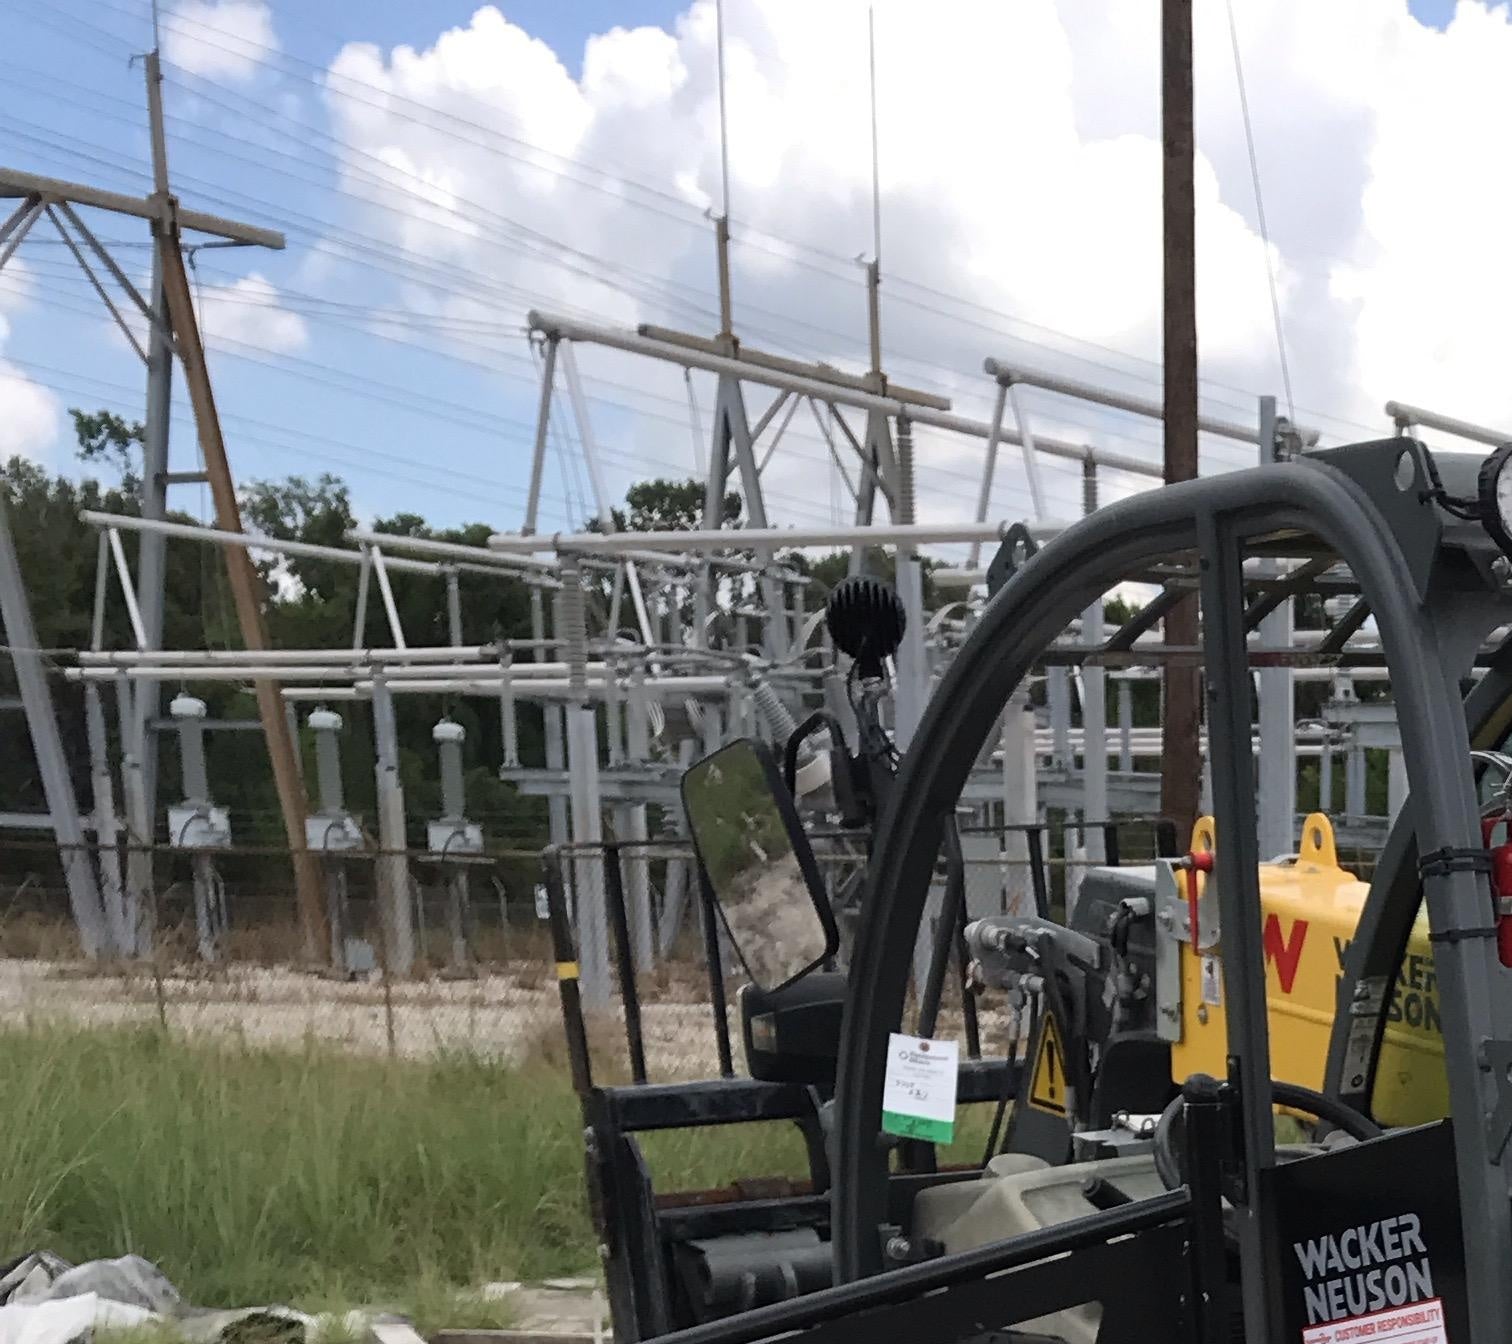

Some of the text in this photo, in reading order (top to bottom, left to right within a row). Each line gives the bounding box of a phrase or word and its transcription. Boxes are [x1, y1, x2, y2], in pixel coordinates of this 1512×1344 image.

[1293, 1212, 1428, 1280] WACKER
[1303, 1257, 1435, 1325] NEUSON
[1334, 1308, 1441, 1342] CUSTOMER RESPONSIBILITY
